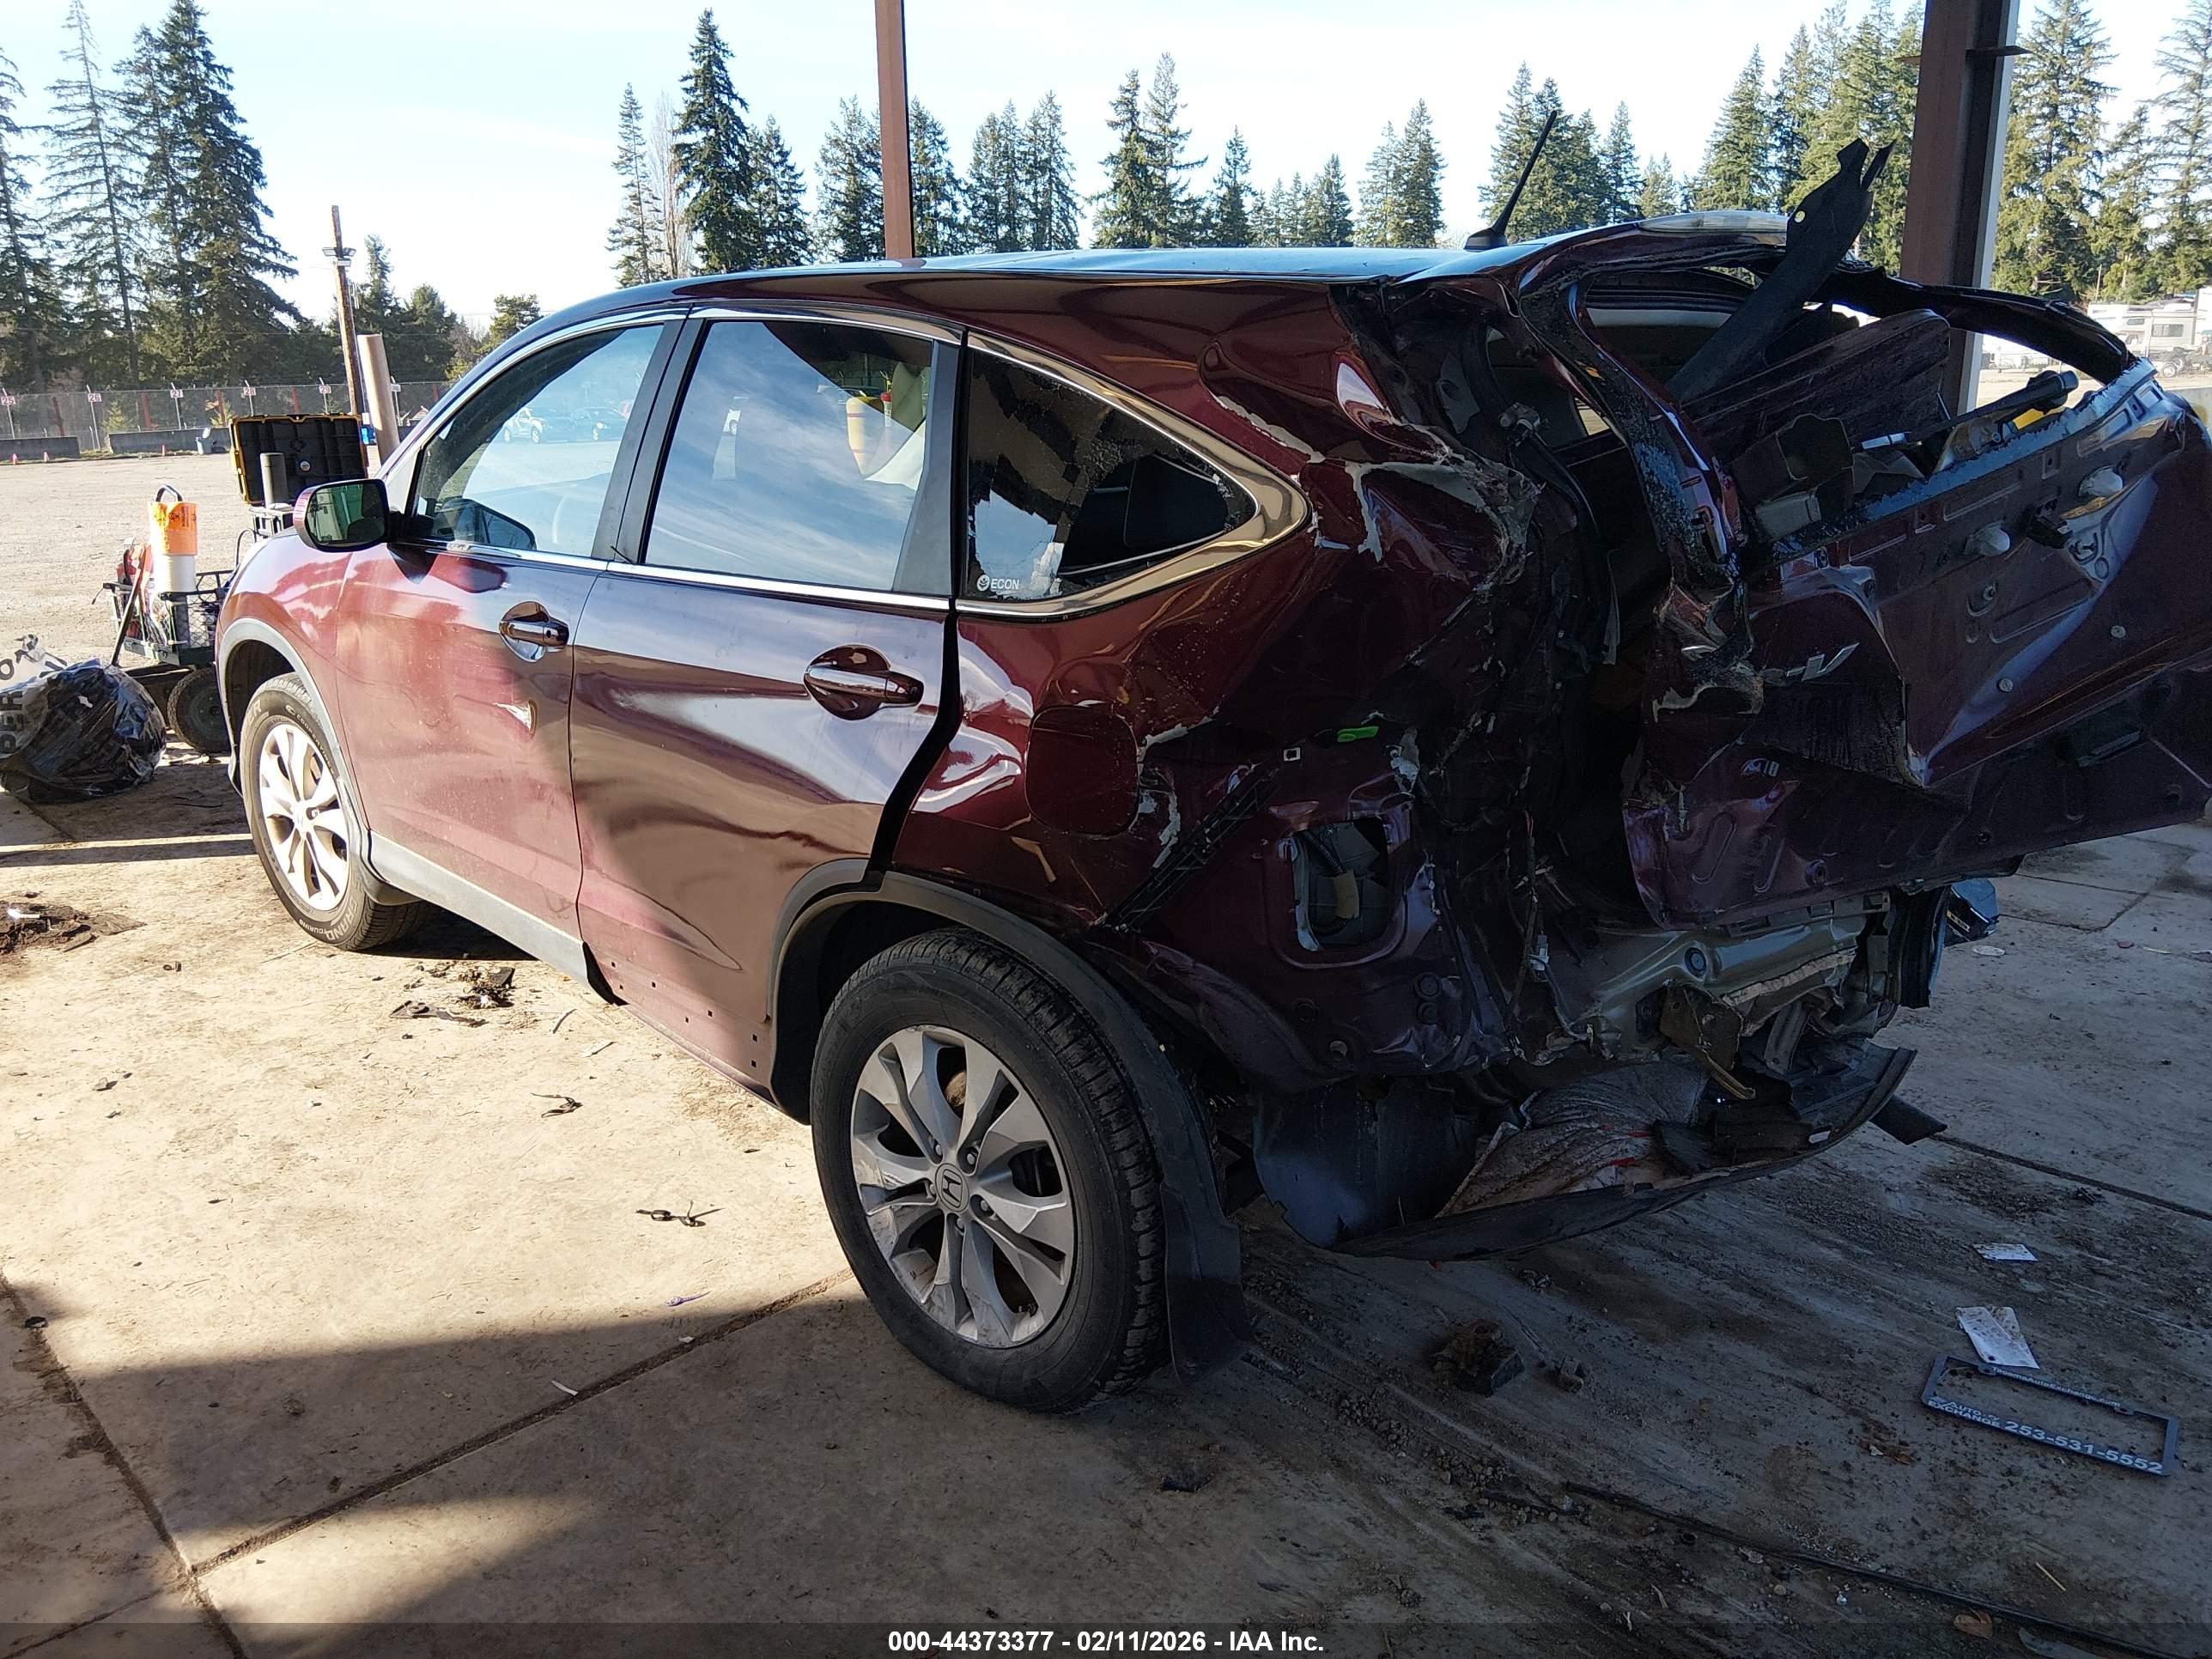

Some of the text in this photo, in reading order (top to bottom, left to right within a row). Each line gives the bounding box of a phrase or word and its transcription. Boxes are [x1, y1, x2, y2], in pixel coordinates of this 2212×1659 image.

[990, 578, 1020, 590] ECON
[1928, 1400, 2001, 1428] EXCHANGE
[2003, 1420, 2164, 1474] 253-531-5552
